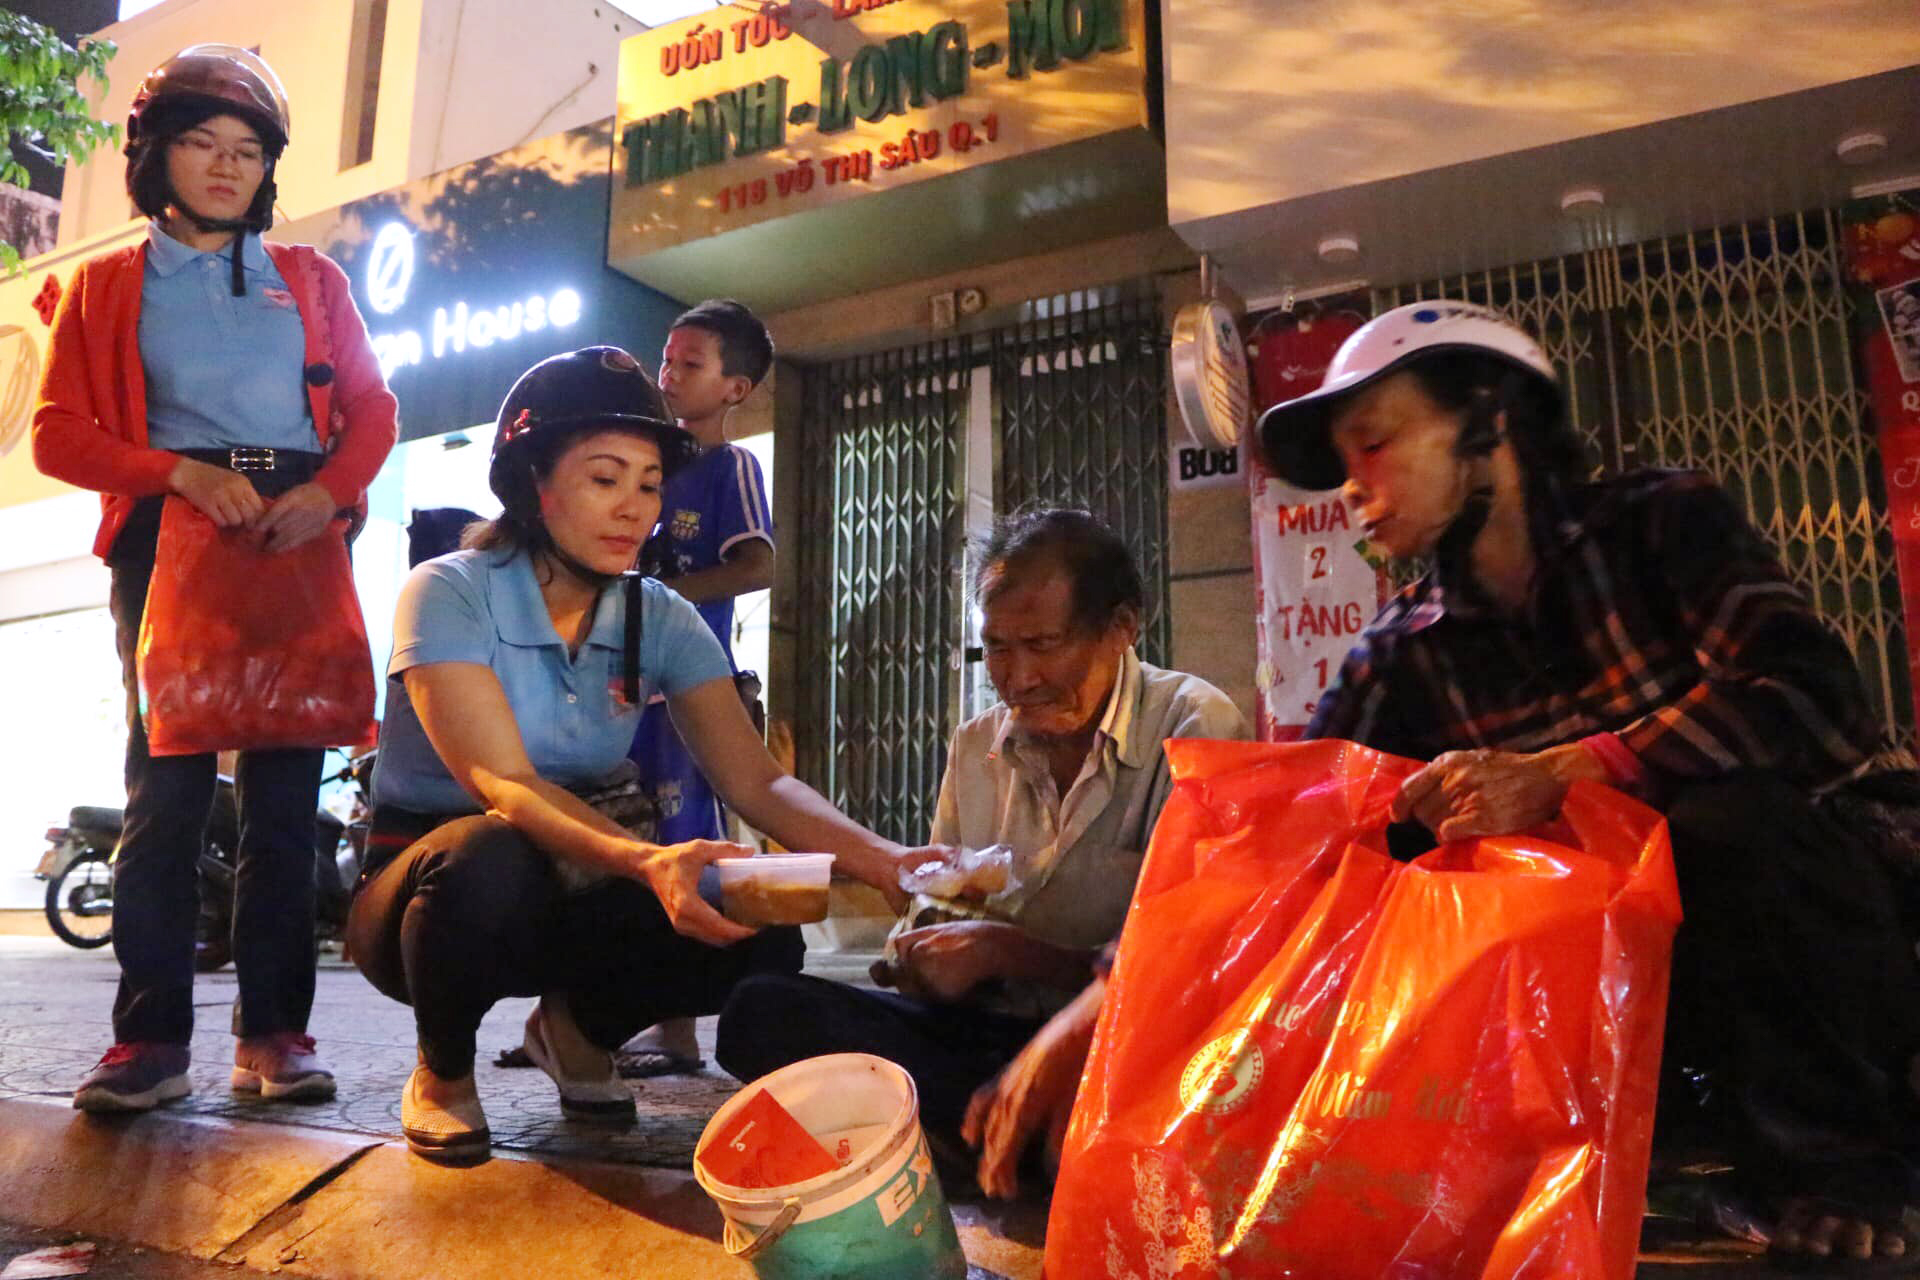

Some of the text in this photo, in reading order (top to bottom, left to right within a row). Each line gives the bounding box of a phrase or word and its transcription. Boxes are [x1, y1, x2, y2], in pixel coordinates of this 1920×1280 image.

[660, 23, 723, 76] UỐN
[775, 158, 815, 197] VÕ
[821, 150, 873, 182] THỊ
[879, 129, 941, 171] SÁU
[433, 288, 581, 359] House
[1277, 500, 1350, 537] MUA
[1311, 547, 1328, 580] 2
[1313, 658, 1329, 690] 1
